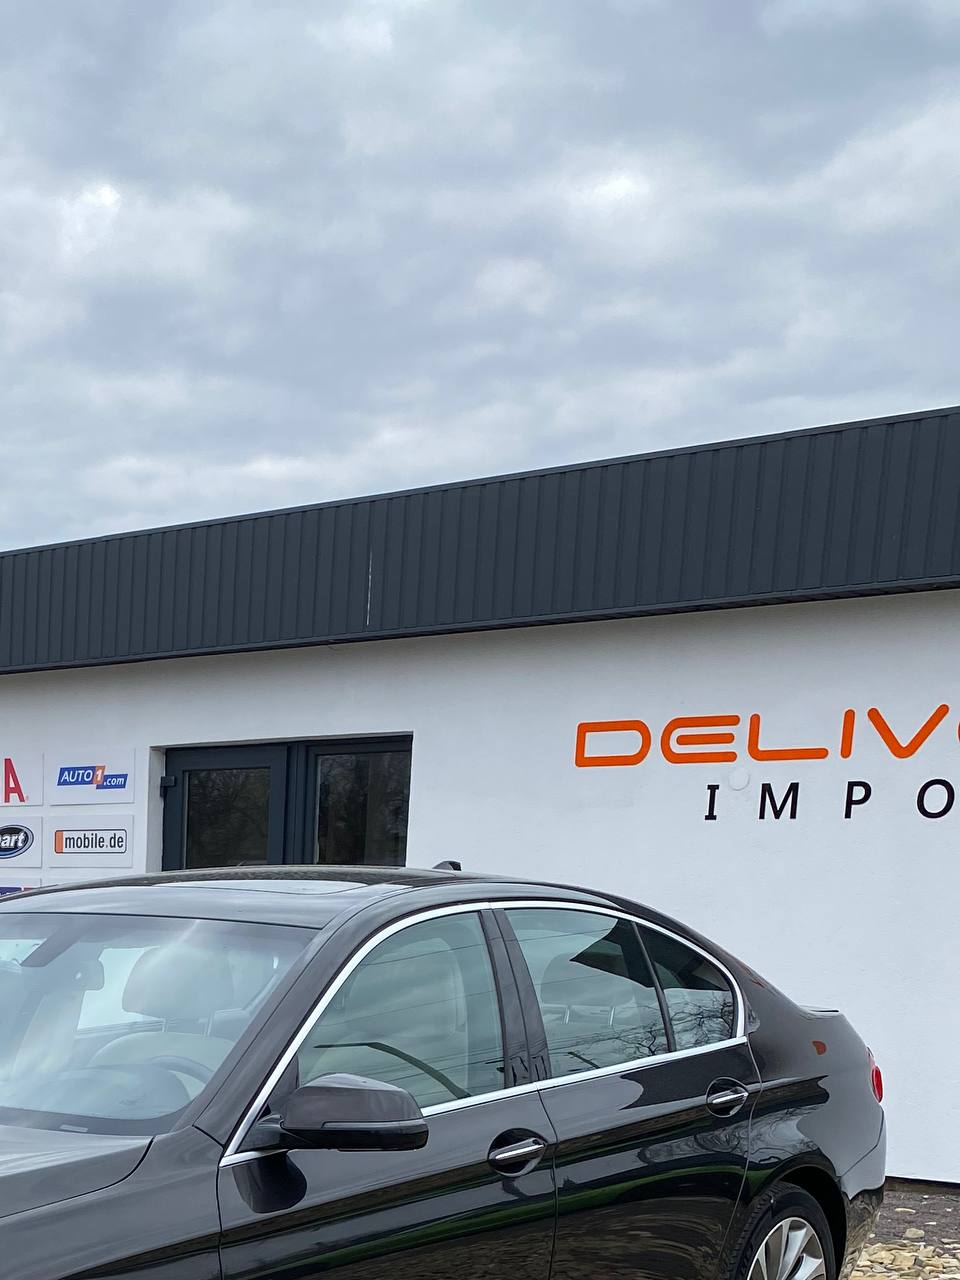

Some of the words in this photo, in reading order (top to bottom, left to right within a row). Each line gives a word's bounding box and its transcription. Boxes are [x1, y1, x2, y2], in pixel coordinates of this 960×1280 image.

[575, 703, 960, 768] DELIV
[704, 778, 955, 821] IMPO
[65, 832, 124, 849] mobile.de
